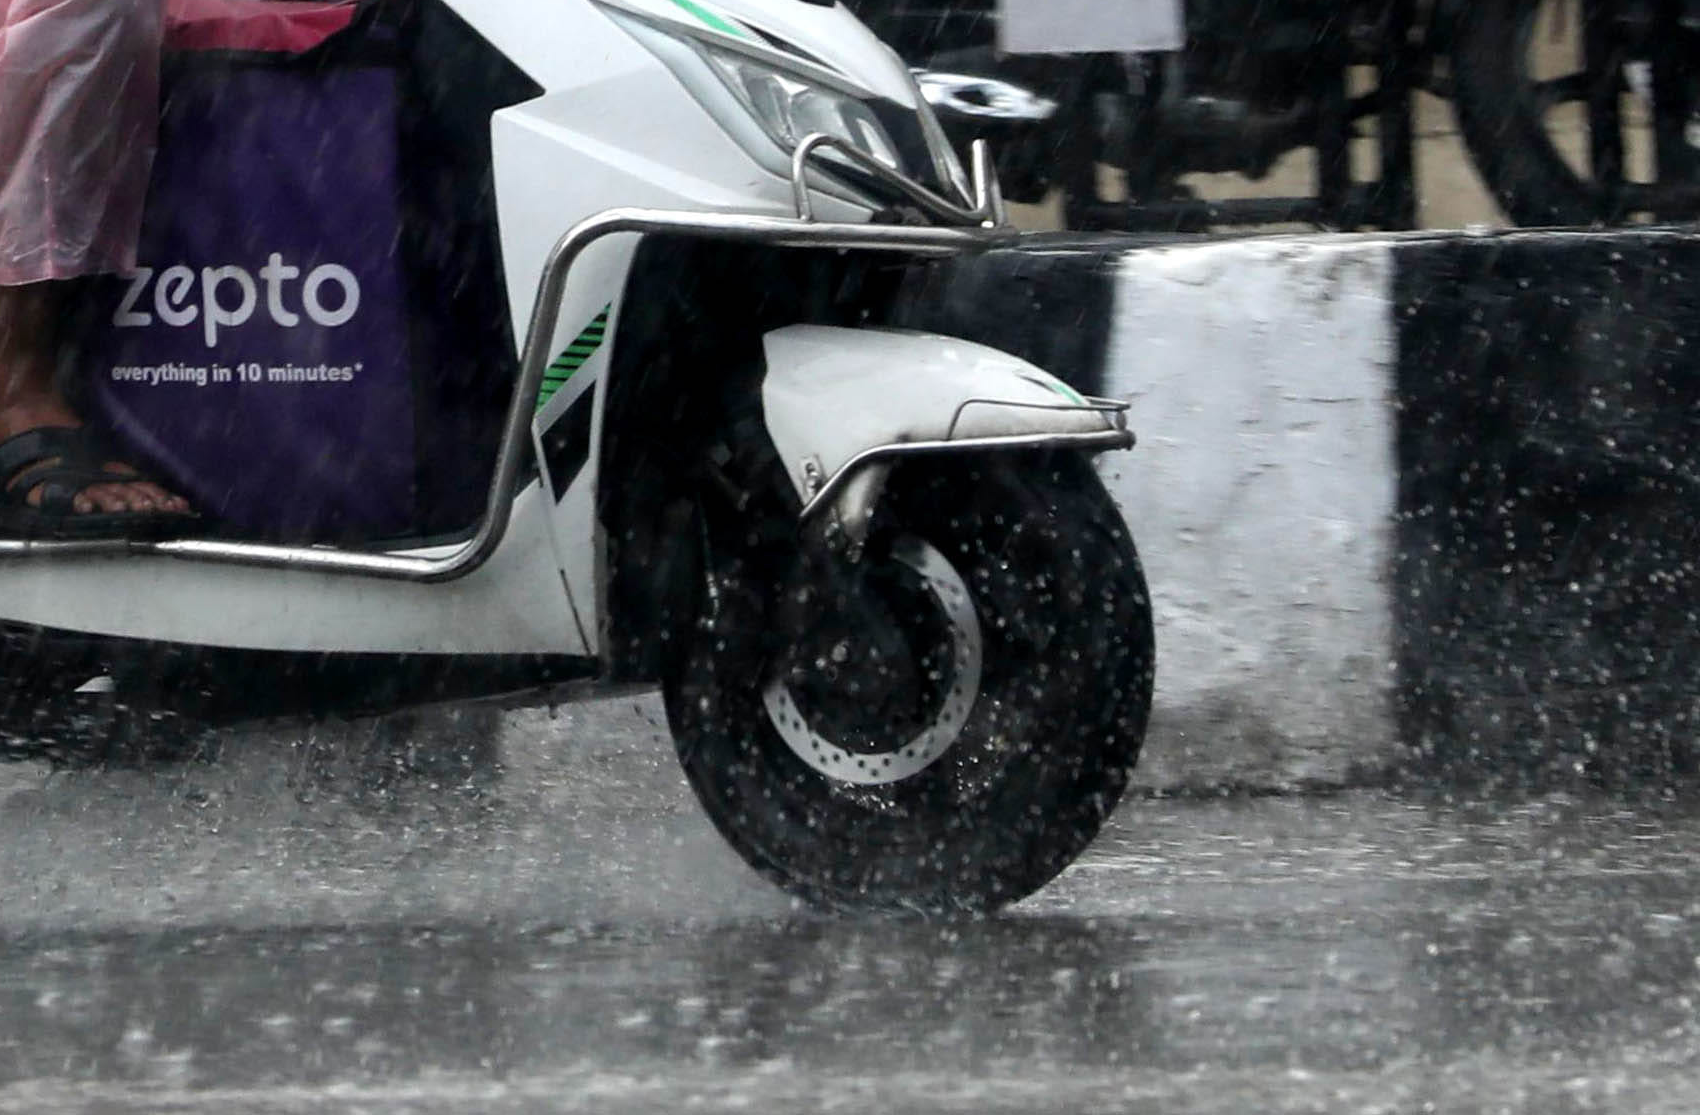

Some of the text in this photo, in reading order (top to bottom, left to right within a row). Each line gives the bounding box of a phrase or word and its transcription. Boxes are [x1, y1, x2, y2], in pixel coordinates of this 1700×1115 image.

[112, 252, 360, 348] zepto
[112, 363, 207, 386] everything
[212, 363, 231, 382] in
[236, 364, 262, 382] 10
